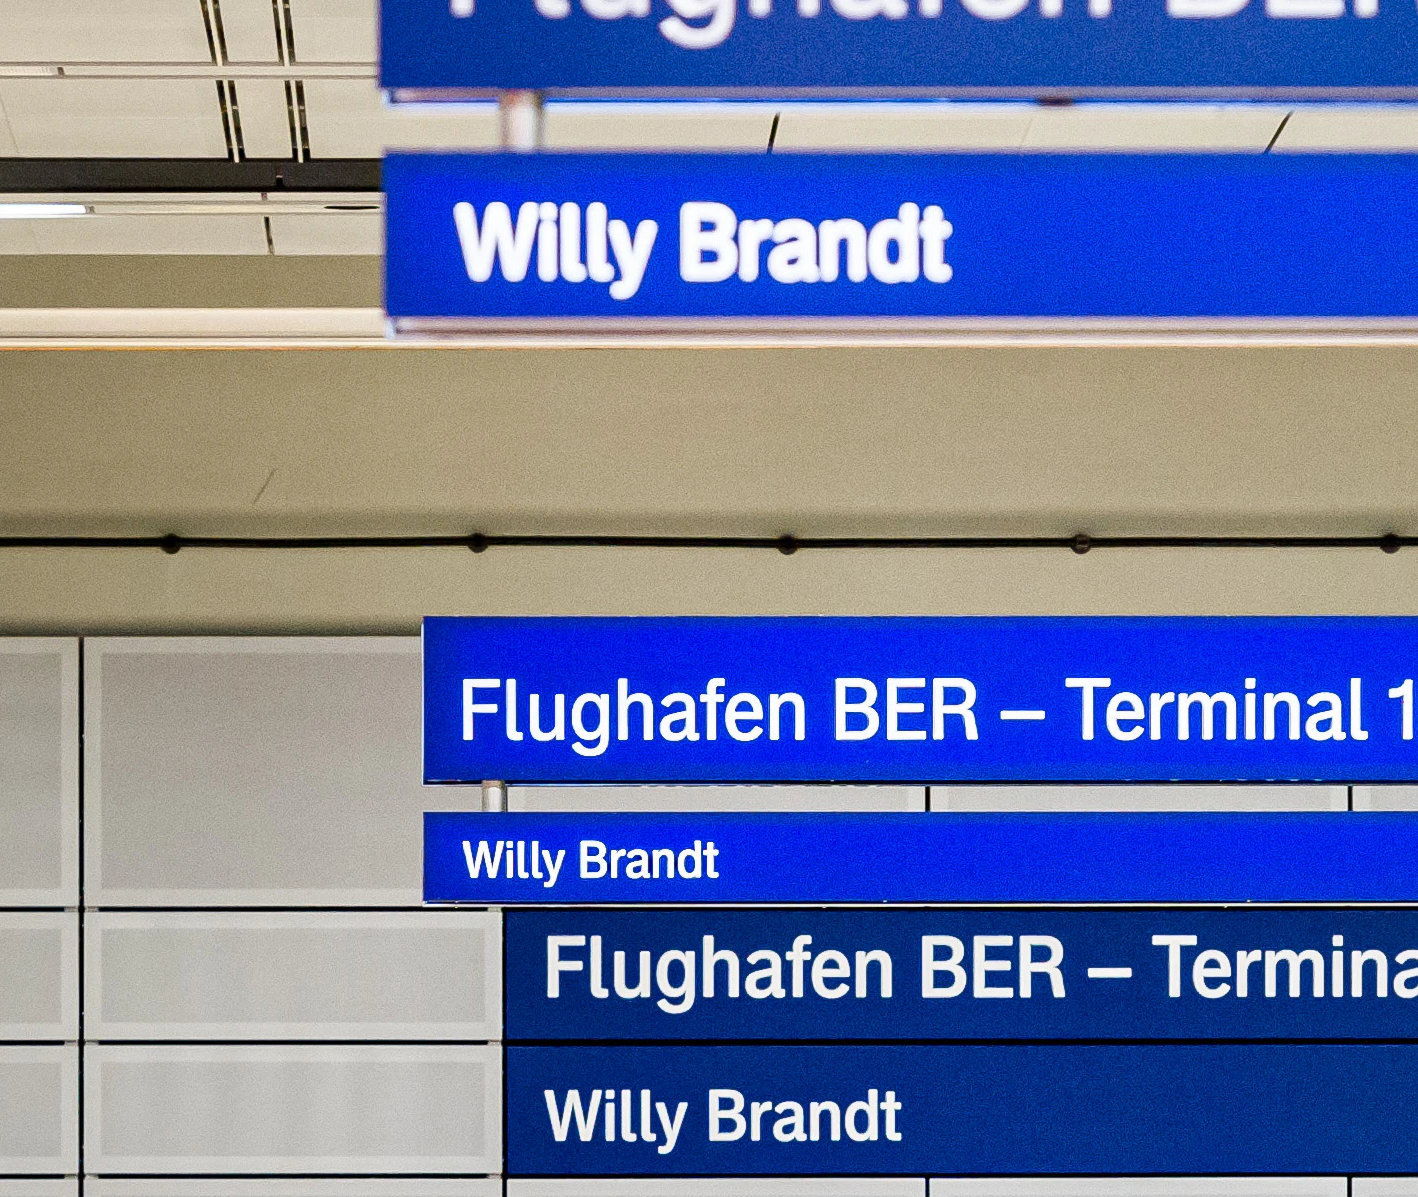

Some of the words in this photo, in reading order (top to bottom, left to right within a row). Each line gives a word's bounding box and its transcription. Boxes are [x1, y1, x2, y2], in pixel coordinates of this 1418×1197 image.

[452, 201, 659, 301] Willy
[679, 201, 954, 285] Brandt
[462, 677, 806, 757] Flughafen
[834, 677, 979, 741] BER
[1064, 677, 1369, 742] Terminal
[461, 839, 566, 888] Willy
[579, 839, 720, 880] Brandt
[546, 934, 893, 1015] Flughafen
[921, 934, 1066, 999] BER
[543, 1088, 689, 1155] Willy
[708, 1088, 902, 1143] Brandt
